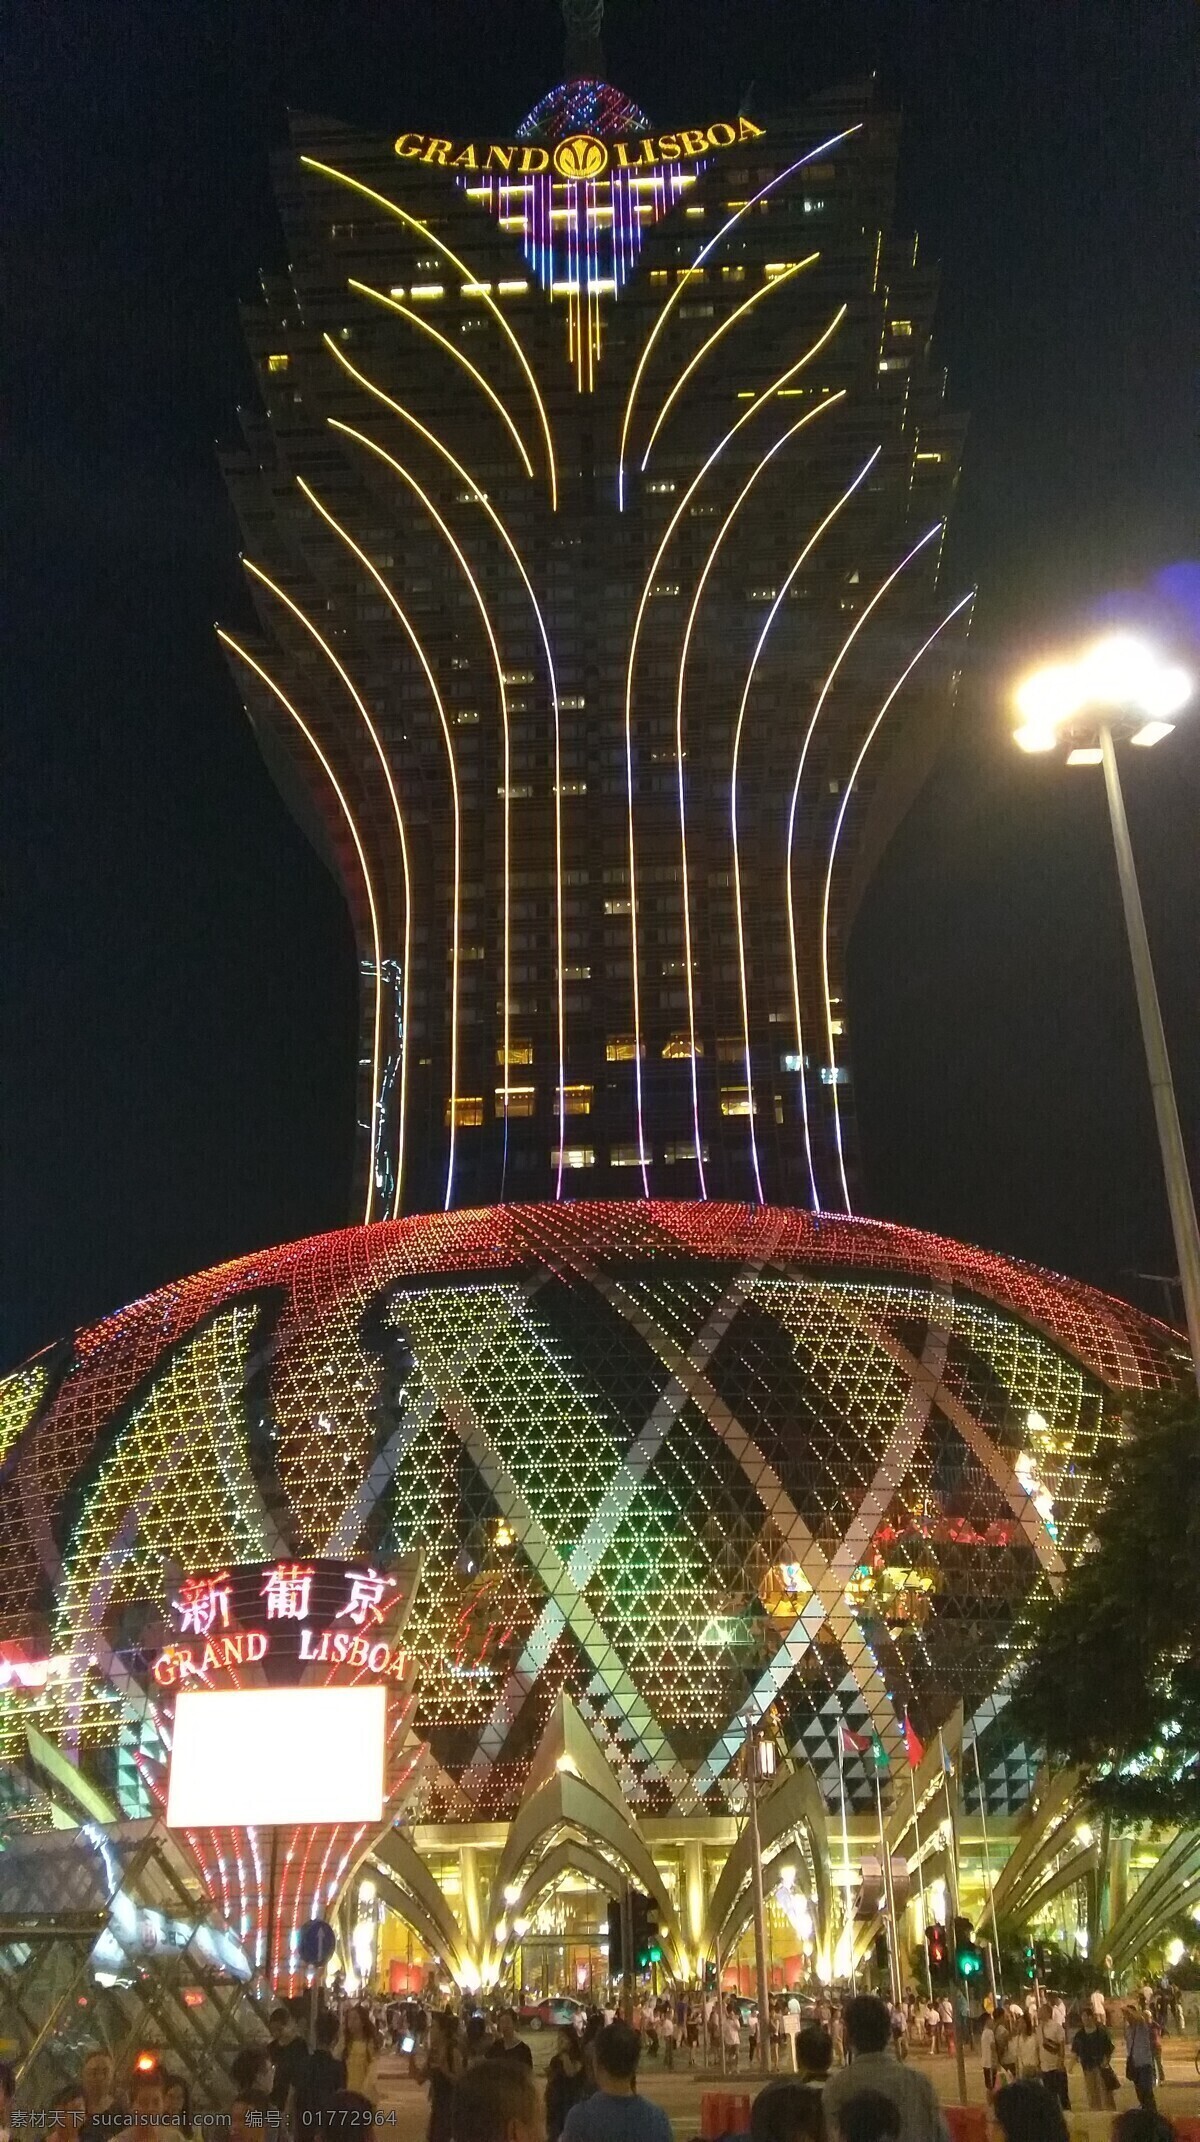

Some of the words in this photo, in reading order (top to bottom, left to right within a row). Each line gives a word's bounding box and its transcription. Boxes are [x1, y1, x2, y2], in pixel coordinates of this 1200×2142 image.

[395, 133, 549, 173] GRAND
[613, 116, 767, 168] LISBOA
[172, 1564, 397, 1634] 新葡京
[153, 1633, 267, 1685] GRAND
[299, 1630, 408, 1681] LISBOA
